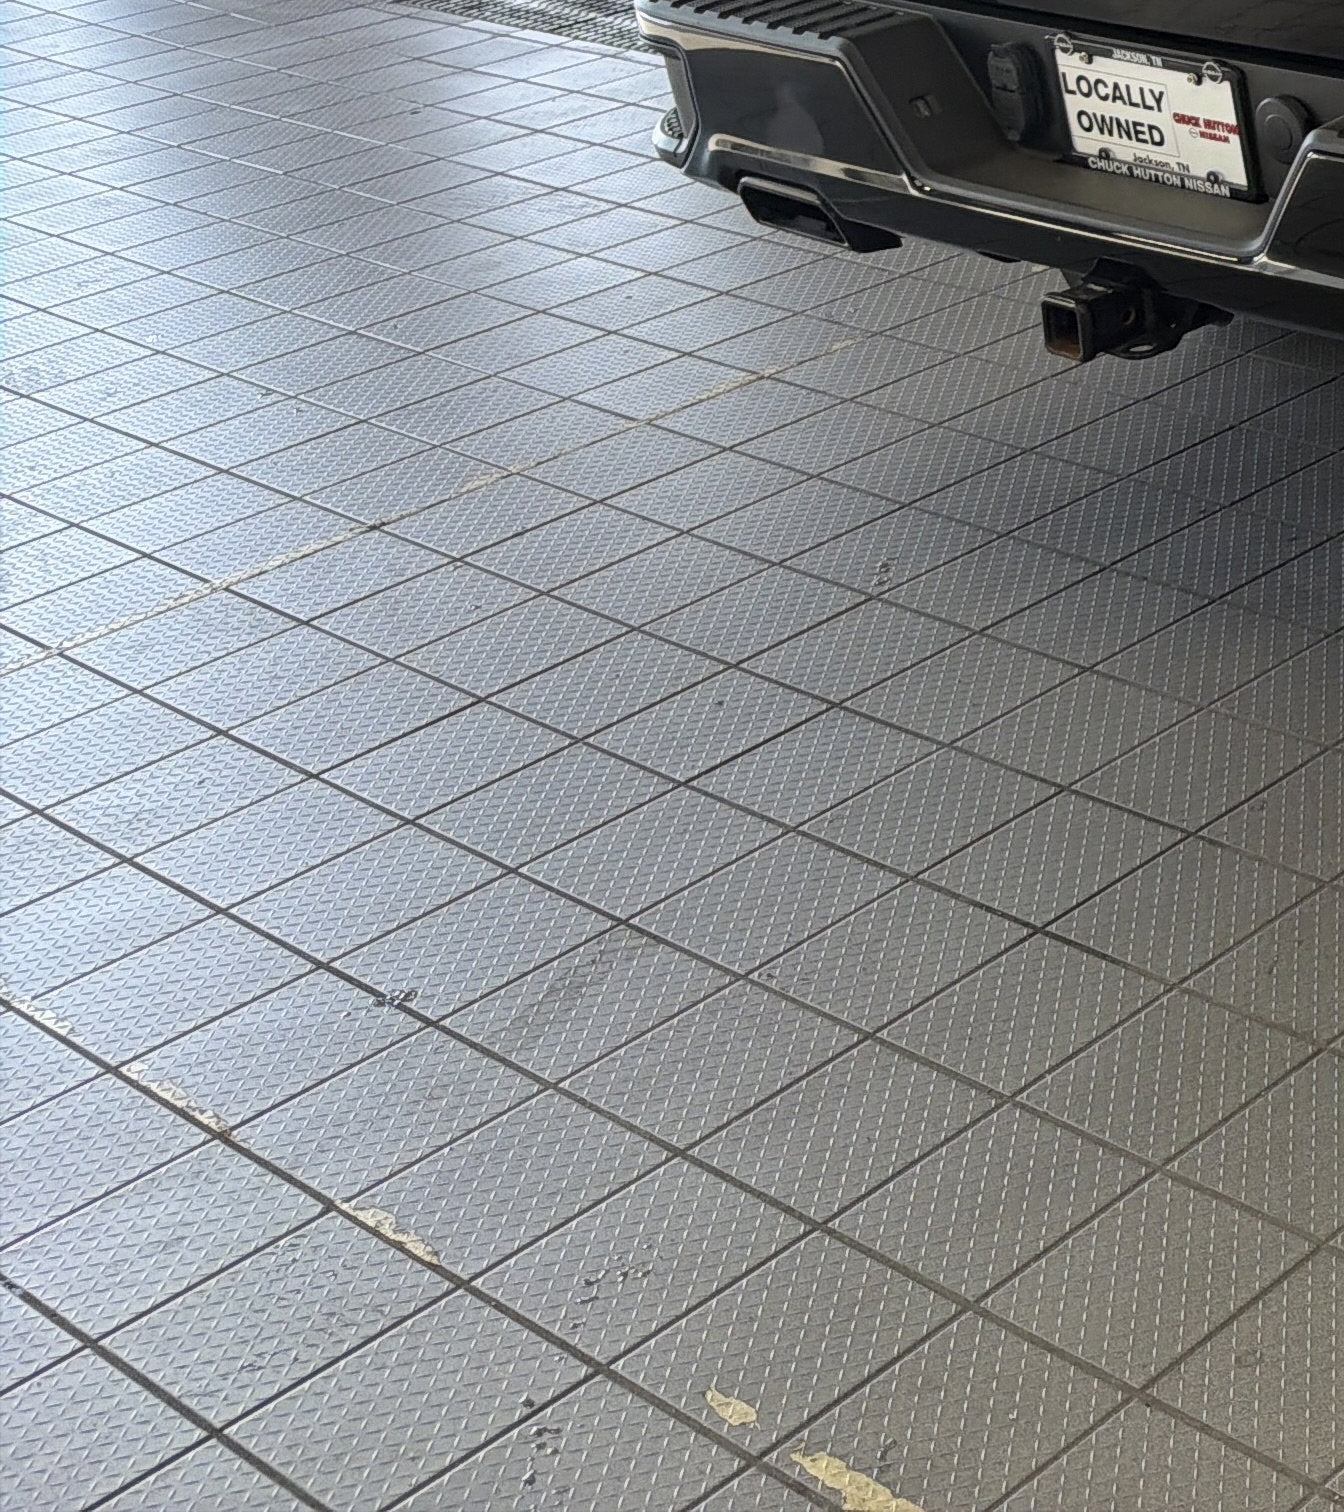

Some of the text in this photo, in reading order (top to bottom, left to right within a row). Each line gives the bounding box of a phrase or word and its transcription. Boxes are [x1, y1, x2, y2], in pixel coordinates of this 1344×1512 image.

[1150, 55, 1163, 68] TN
[1061, 71, 1164, 113] LOCALLY
[1077, 109, 1165, 147] OWNED
[1173, 112, 1202, 129] CHUCK
[1199, 130, 1231, 145] NISSAN
[1132, 152, 1191, 174] Jackson, TN
[1087, 156, 1231, 198] CHUCK HUTTON NISSAN
